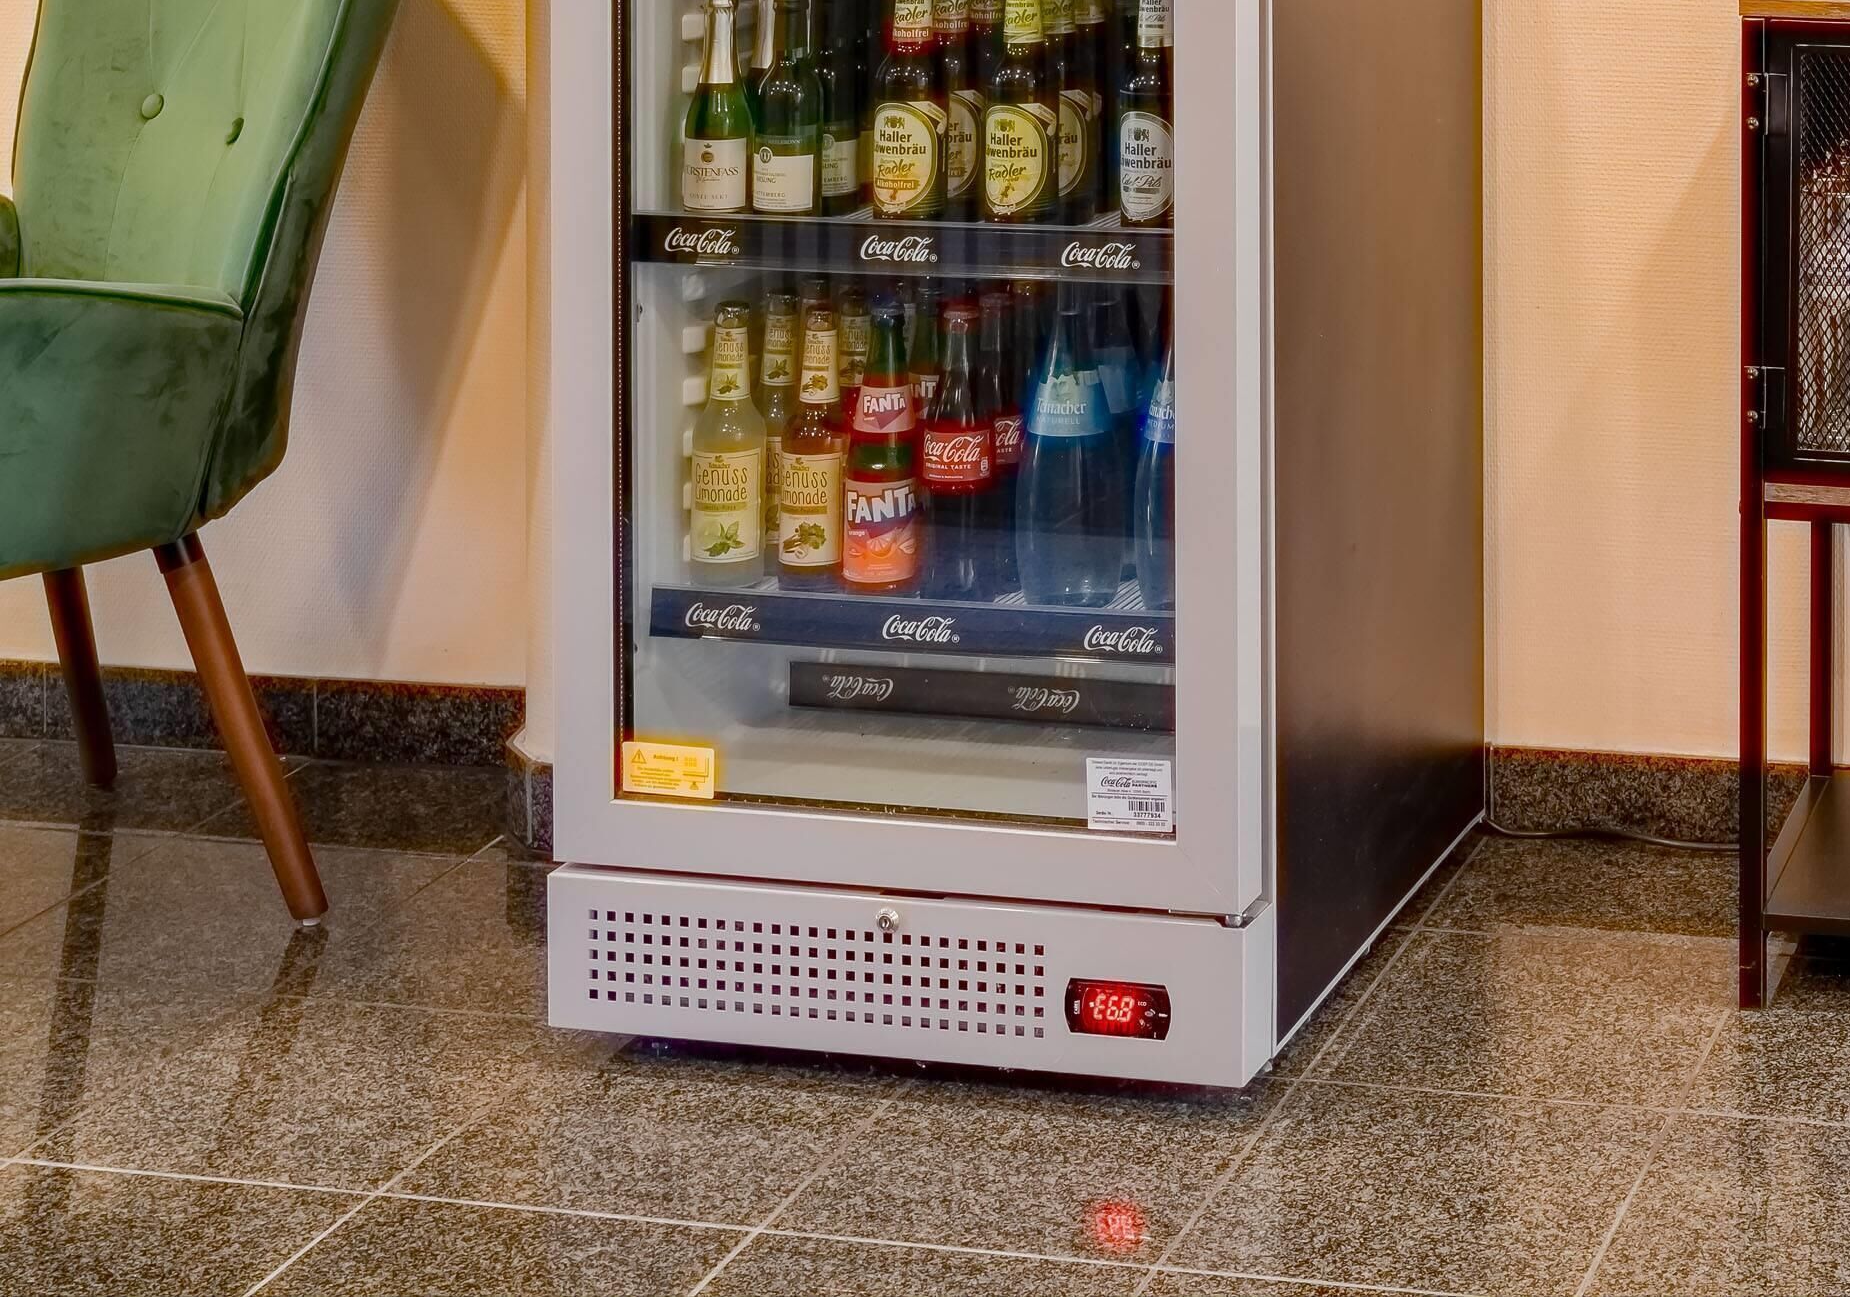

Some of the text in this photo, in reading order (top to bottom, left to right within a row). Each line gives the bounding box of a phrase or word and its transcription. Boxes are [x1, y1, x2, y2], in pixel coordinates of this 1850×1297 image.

[879, 130, 913, 143] Haller
[990, 133, 1023, 146] Haller
[1124, 142, 1157, 156] Haller
[877, 158, 916, 178] Radler
[988, 163, 1027, 181] Radler
[863, 393, 906, 414] FANTA
[695, 462, 748, 486] Genuss
[847, 486, 916, 524] FANTA
